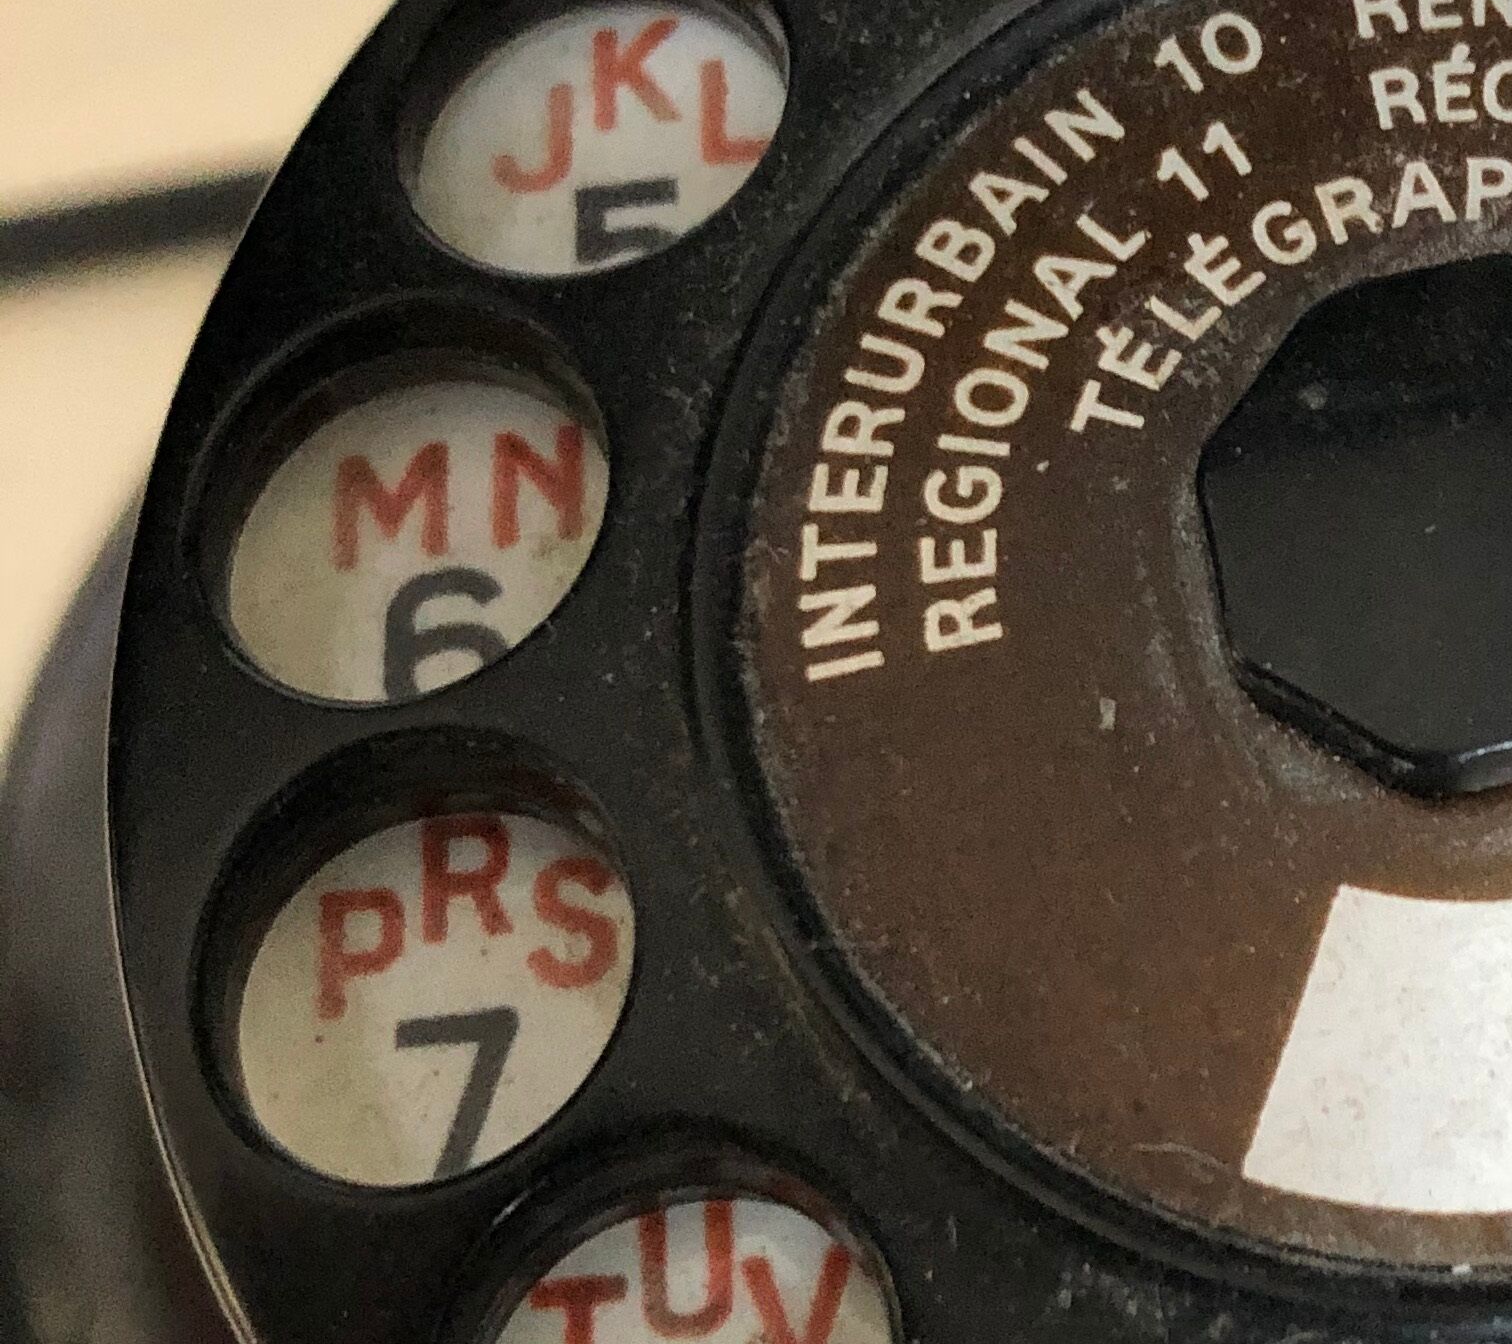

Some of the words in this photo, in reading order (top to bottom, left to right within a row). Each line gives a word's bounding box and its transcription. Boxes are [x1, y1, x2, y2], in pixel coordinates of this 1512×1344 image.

[492, 18, 770, 194] JKL
[798, 90, 1126, 683] INTERURBAIN
[1154, 10, 1265, 93] 10
[917, 212, 1150, 653] REGIONAL
[1155, 120, 1255, 203] 11
[330, 425, 587, 571] MN
[382, 564, 510, 704] 6
[315, 816, 624, 1020] PRS
[395, 1006, 519, 1182] 7
